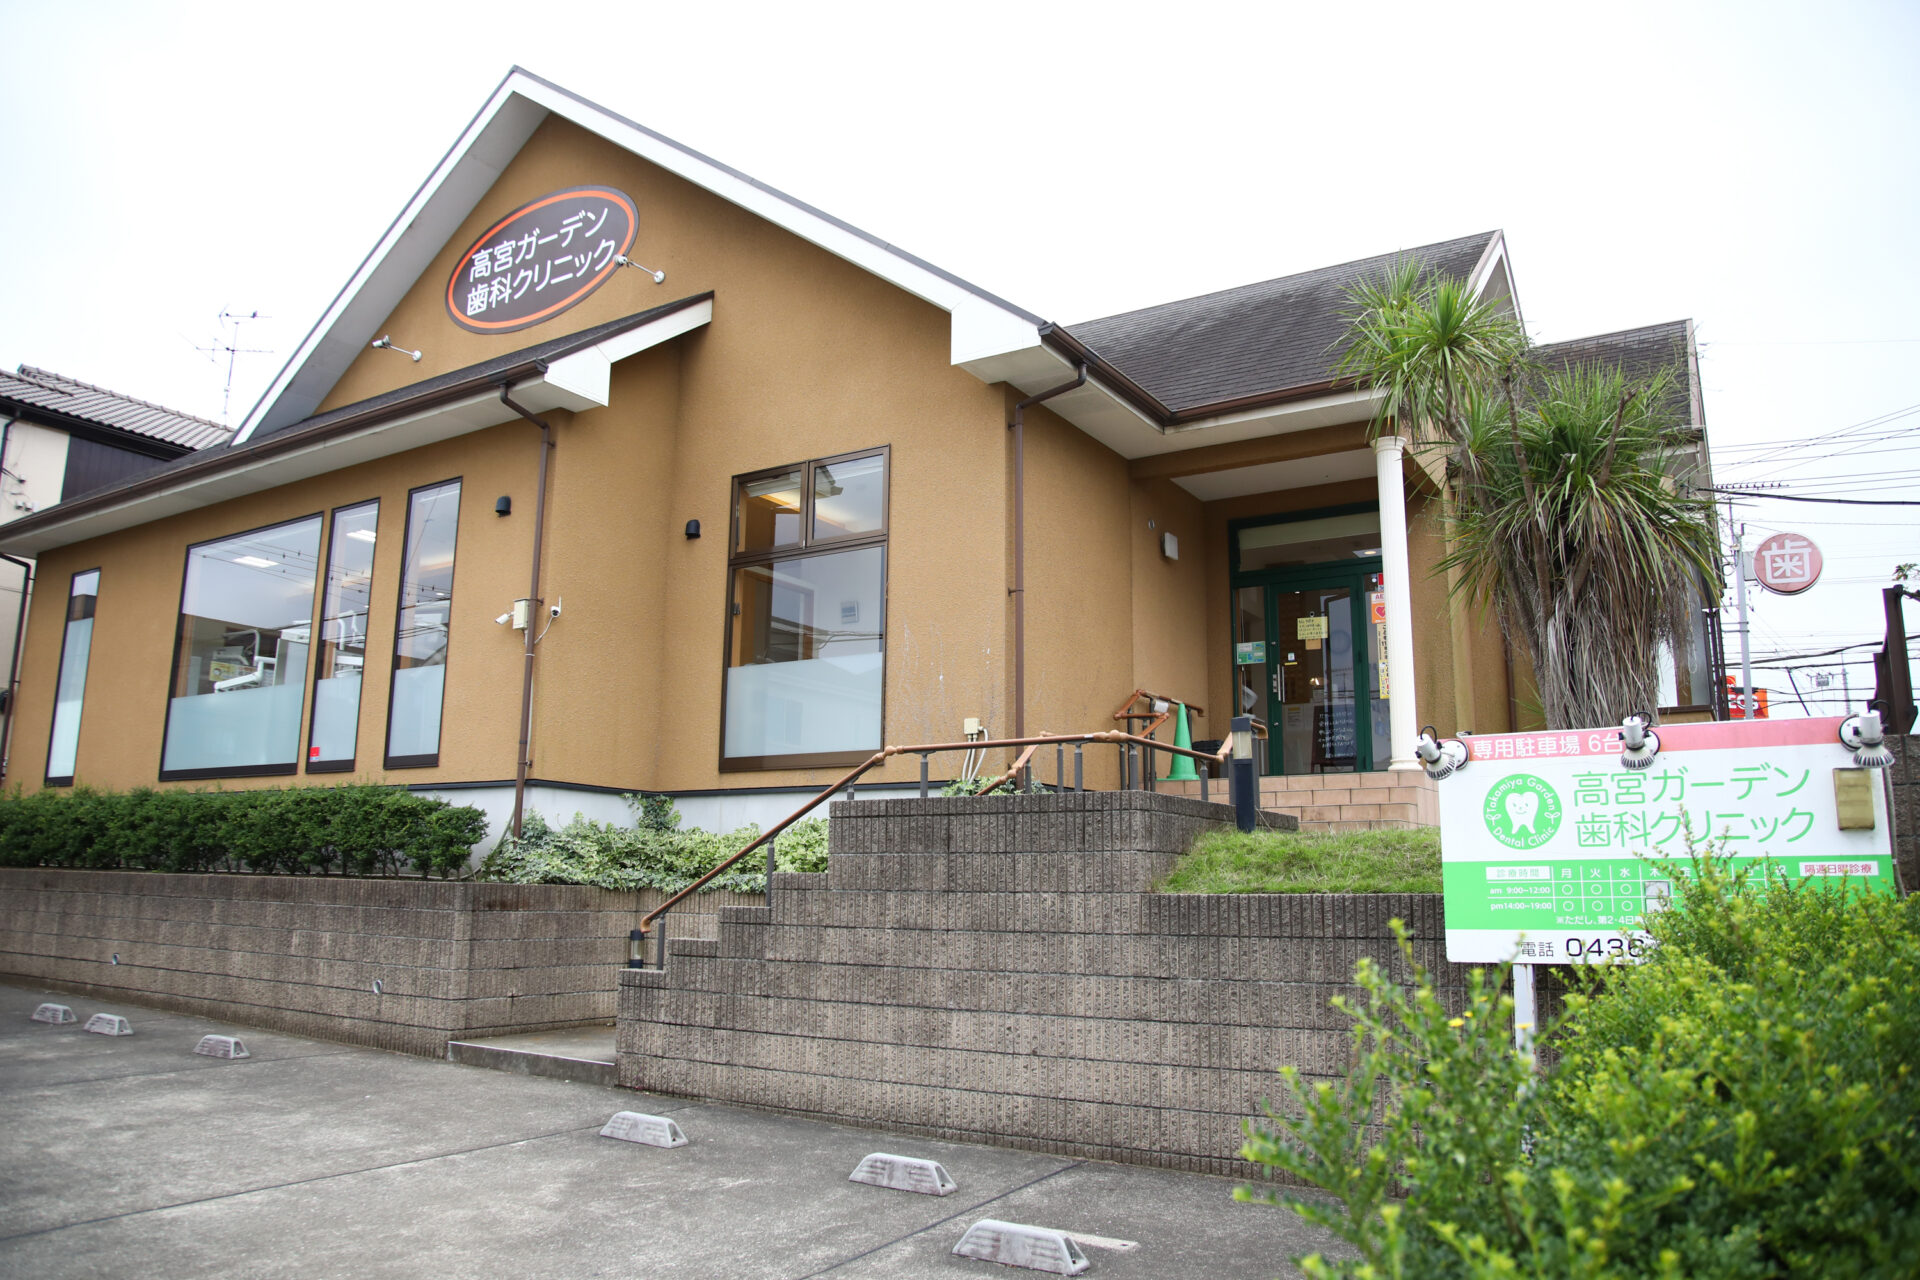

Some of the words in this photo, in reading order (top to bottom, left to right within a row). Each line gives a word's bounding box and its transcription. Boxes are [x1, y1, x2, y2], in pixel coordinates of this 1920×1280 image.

[469, 208, 608, 283] 高宮ガーデン
[466, 238, 615, 316] 歯科クリニック
[1761, 538, 1813, 584] 歯
[1472, 736, 1581, 759] 専用駐車場
[1588, 732, 1624, 754] 6台
[1486, 778, 1523, 812] Takamiya
[1527, 777, 1556, 811] Garden
[1571, 761, 1811, 807] 高宮ガーデン
[1493, 826, 1525, 848] Dental
[1528, 827, 1555, 847] Clinic
[1576, 806, 1815, 848] 歯科クリニック
[1496, 868, 1540, 878] 診療時間
[1561, 868, 1572, 878] 月
[1590, 868, 1601, 878] 火
[1619, 867, 1631, 878] 水
[1520, 941, 1554, 957] 電話
